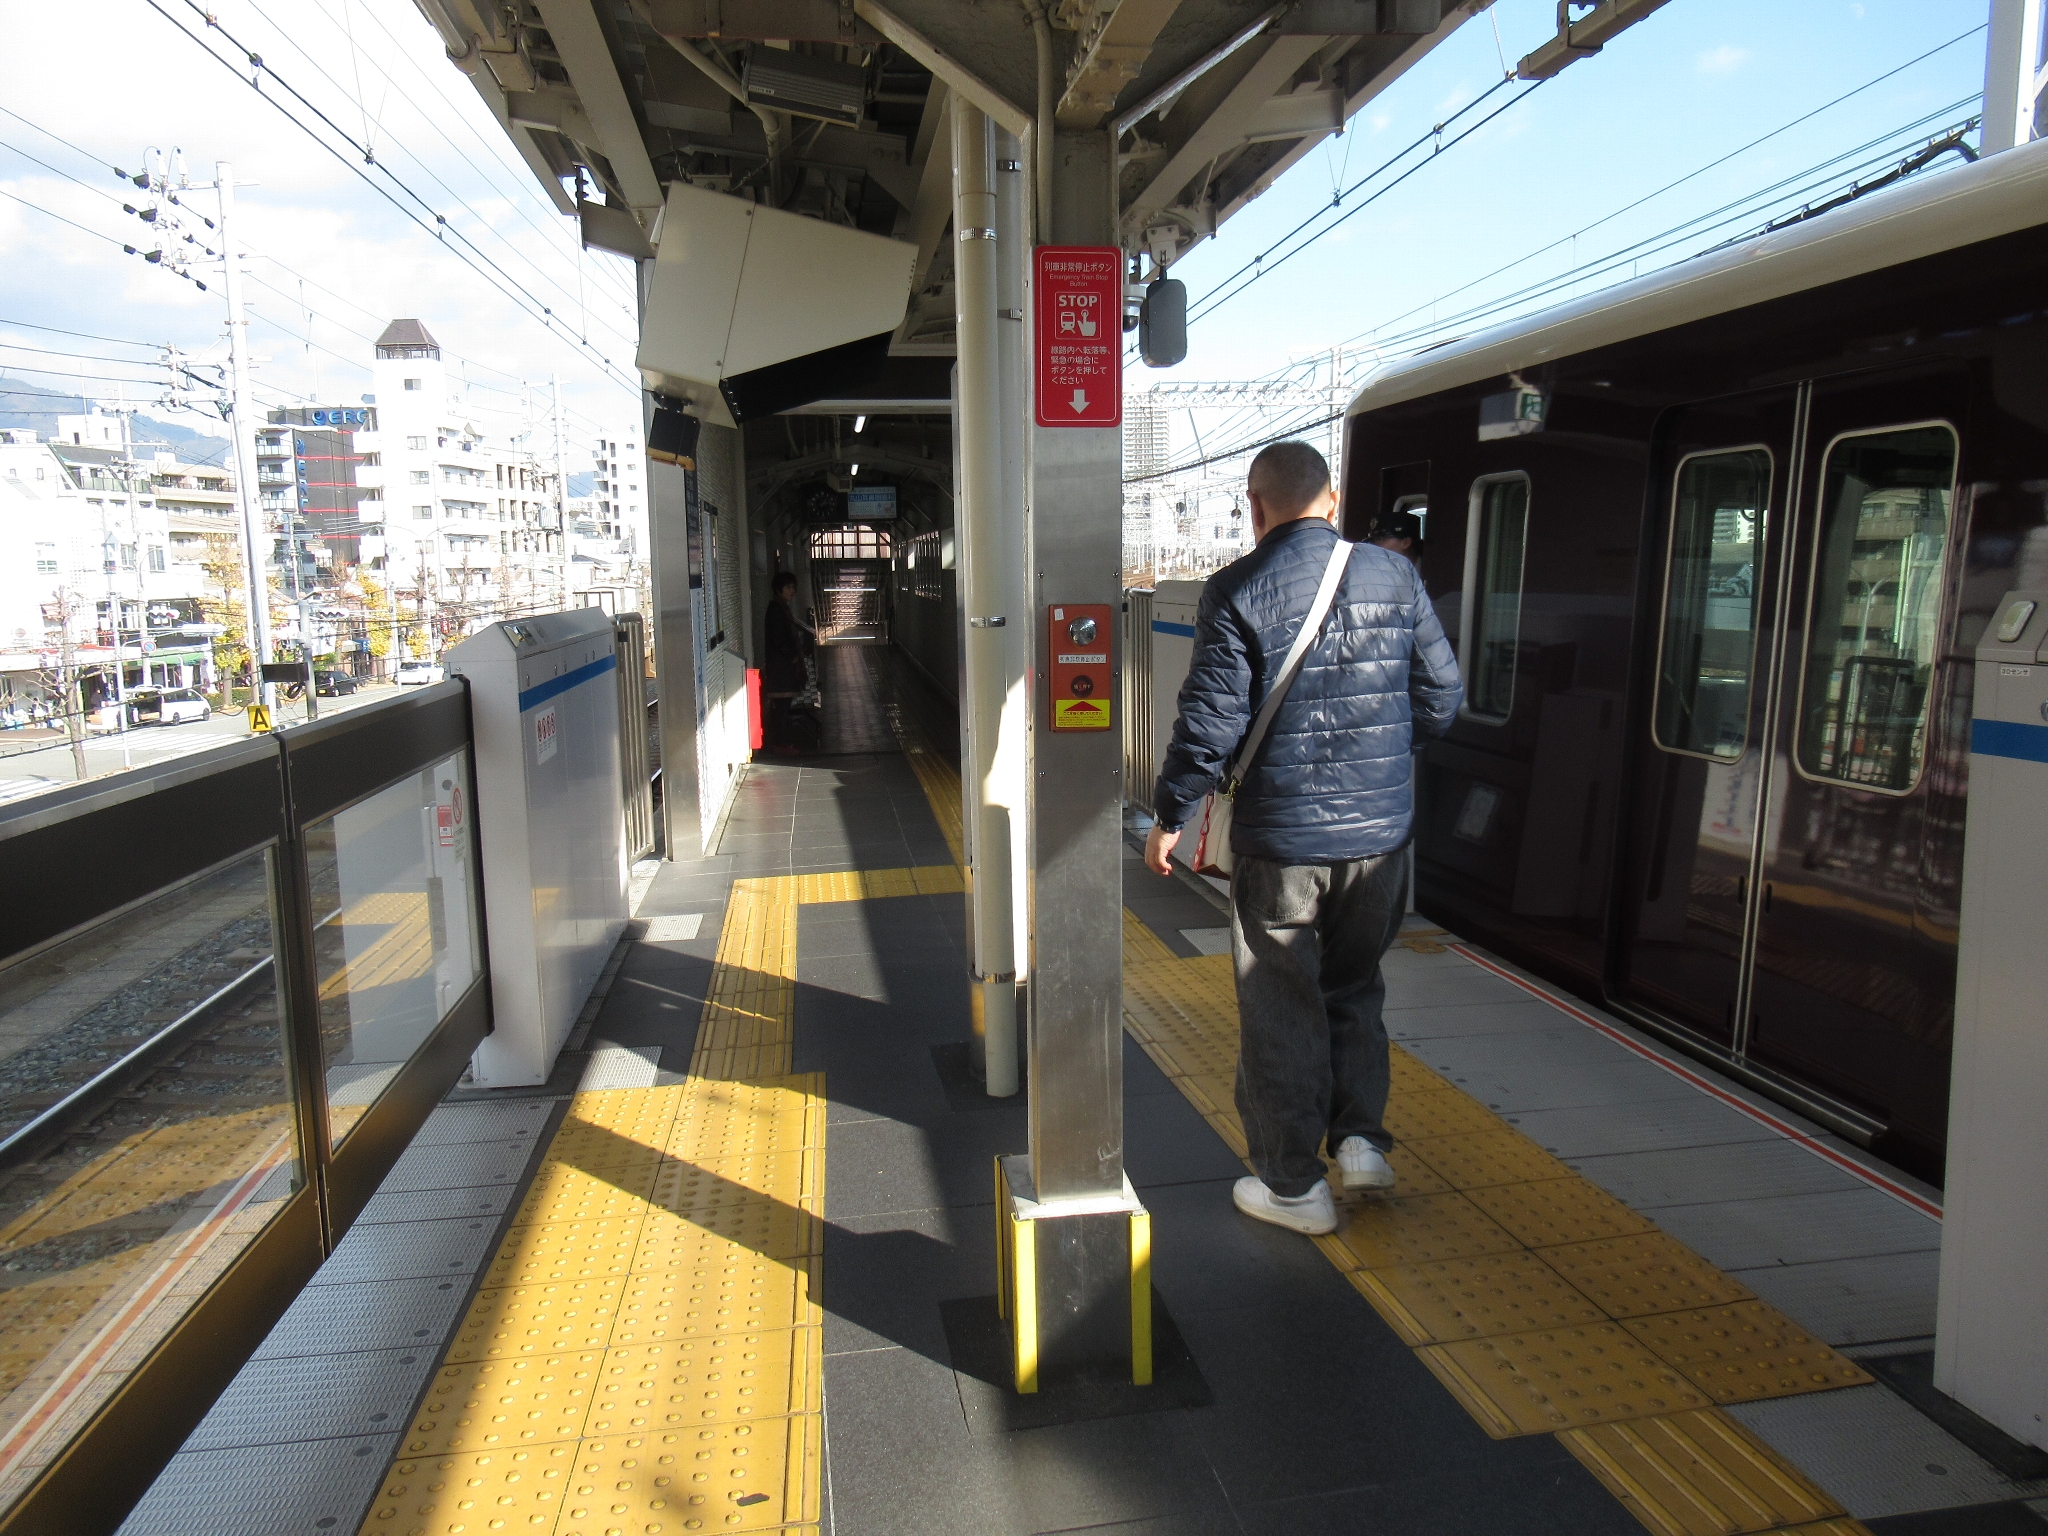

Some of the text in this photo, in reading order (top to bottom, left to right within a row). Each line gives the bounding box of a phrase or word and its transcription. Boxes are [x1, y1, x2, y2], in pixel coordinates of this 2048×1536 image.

[1045, 261, 1112, 272] 列車非常停止ボタン
[1058, 295, 1098, 307] STOP
[1051, 356, 1099, 365] 緊急の場合に
[1051, 366, 1107, 375] ボタンを押して
[1051, 376, 1084, 385] ください
[253, 708, 269, 729] A
